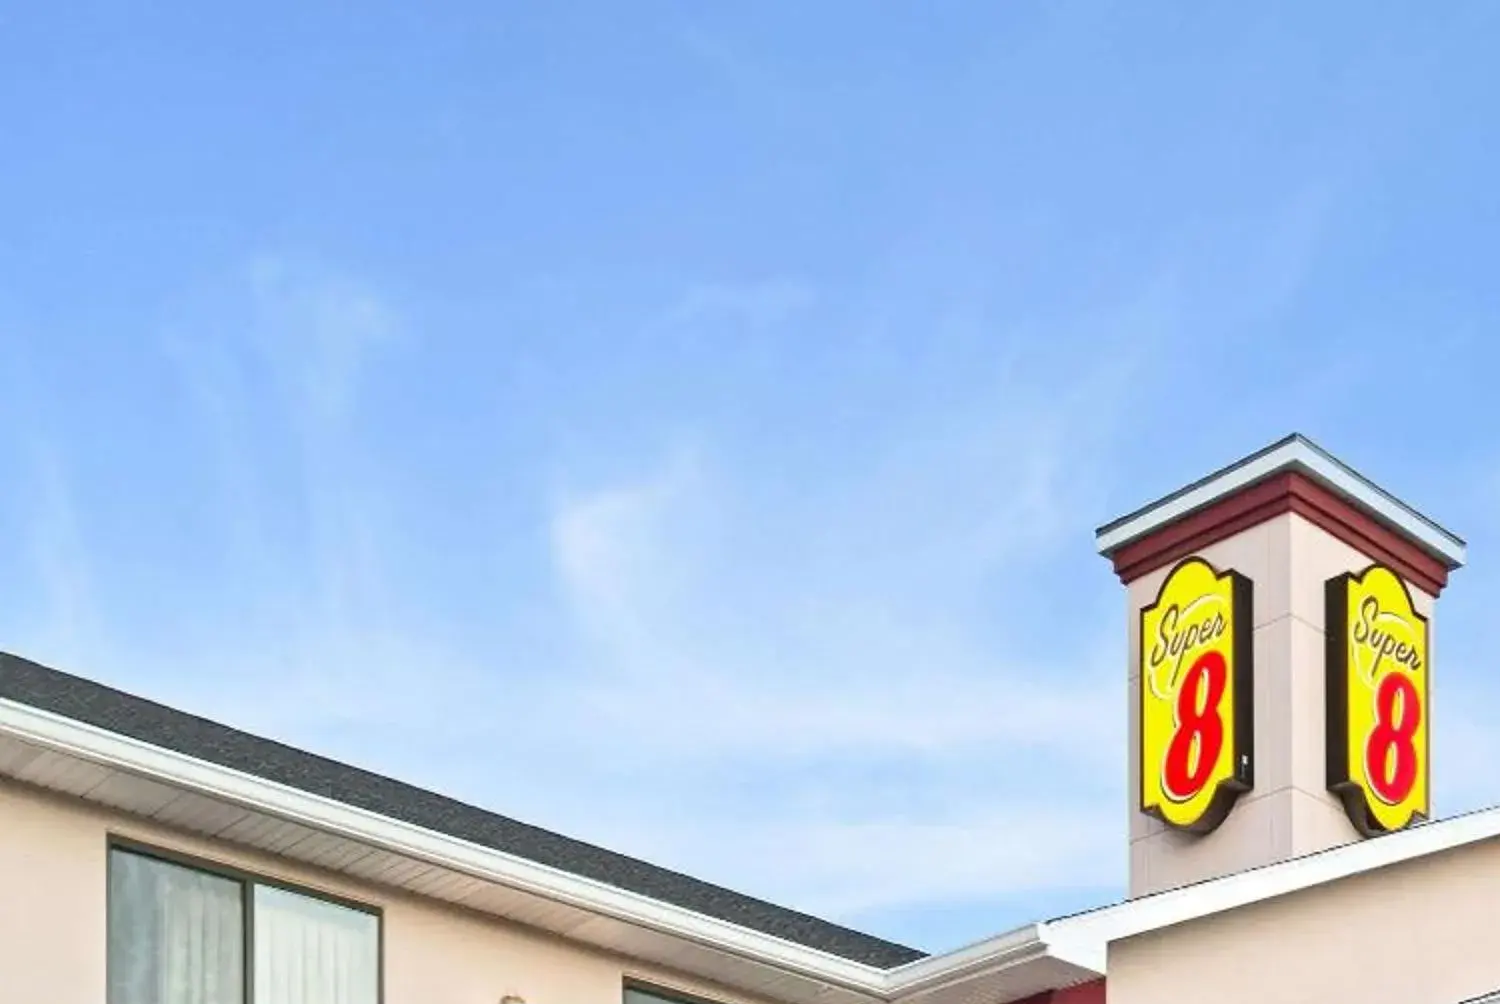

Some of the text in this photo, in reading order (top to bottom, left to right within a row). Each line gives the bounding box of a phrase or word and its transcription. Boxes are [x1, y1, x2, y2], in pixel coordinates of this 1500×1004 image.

[1151, 604, 1227, 686] Super
[1354, 597, 1421, 677] Super
[1163, 650, 1228, 799] 8
[1366, 672, 1422, 804] 8
